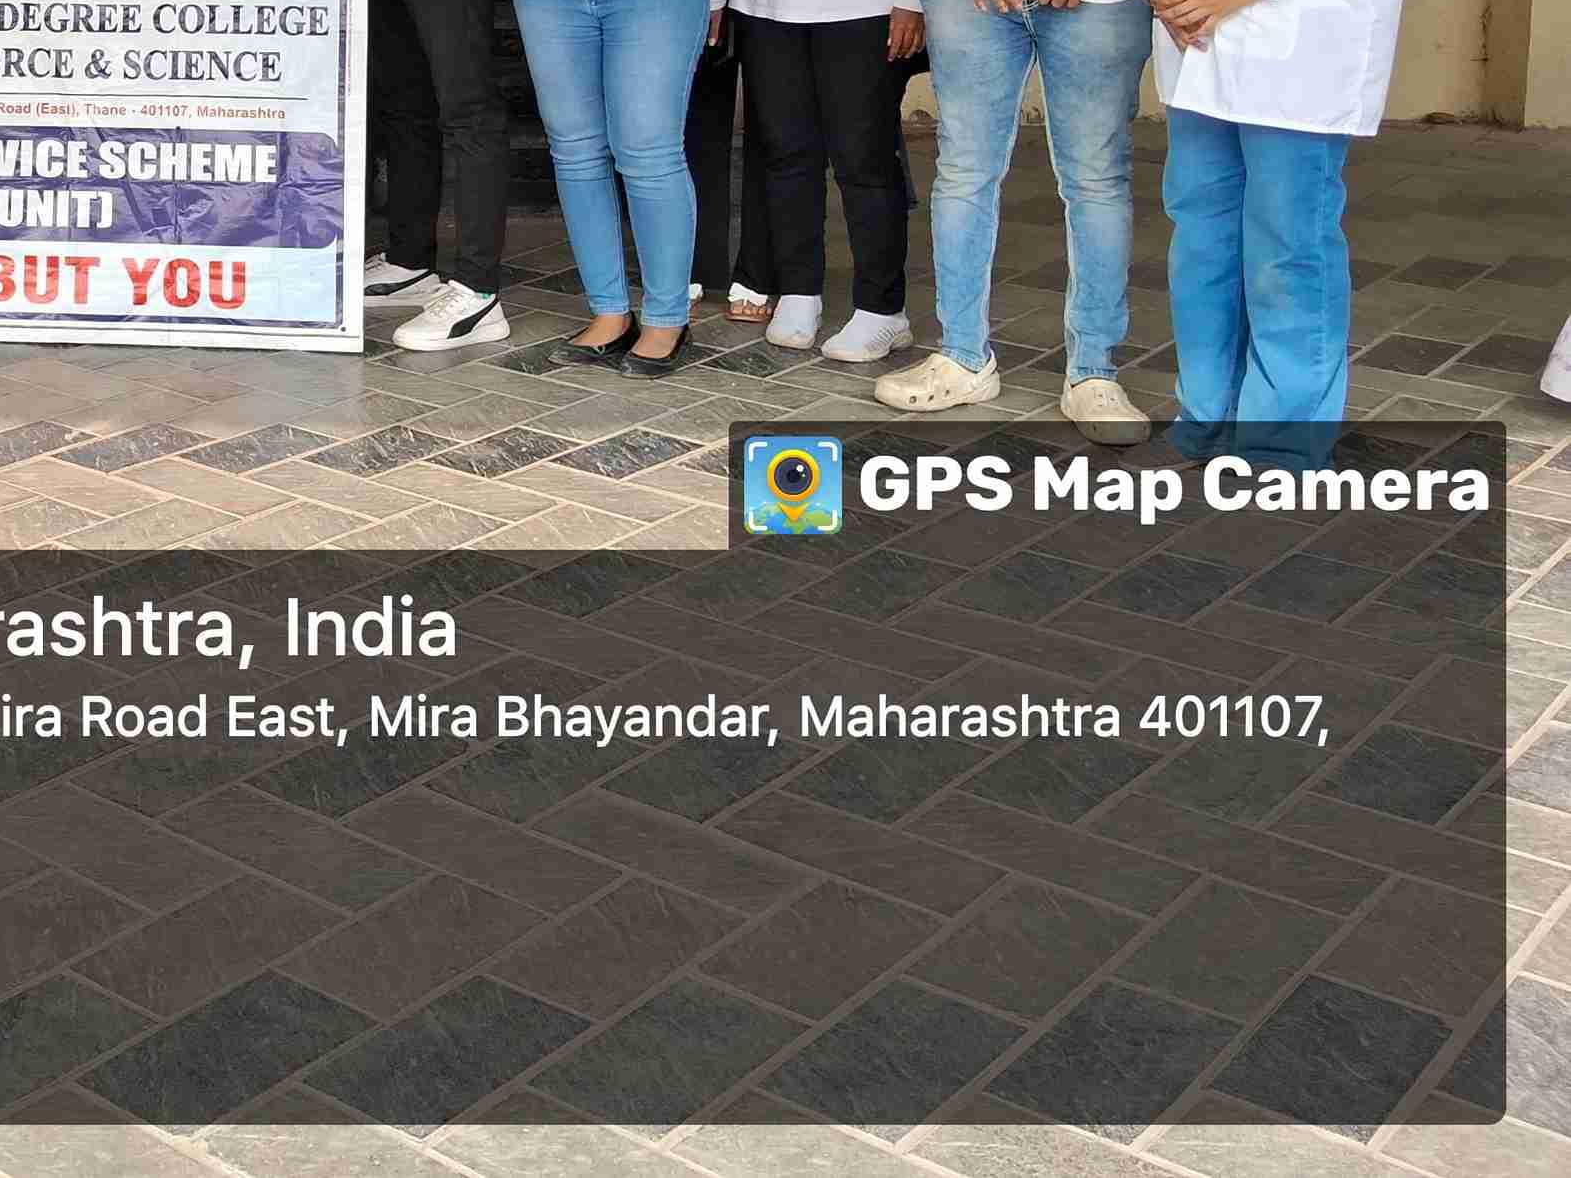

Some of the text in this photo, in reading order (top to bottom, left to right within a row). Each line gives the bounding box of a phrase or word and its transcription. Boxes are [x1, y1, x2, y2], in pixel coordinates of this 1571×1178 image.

[152, 3, 330, 36] COLLEGE
[83, 48, 113, 79] &
[122, 49, 283, 82] SCIENCE
[85, 103, 128, 117] Thane
[140, 104, 193, 119] 401107,
[196, 105, 287, 120] Maharashtra
[97, 140, 278, 183] SCHEME
[121, 257, 248, 310] YOU
